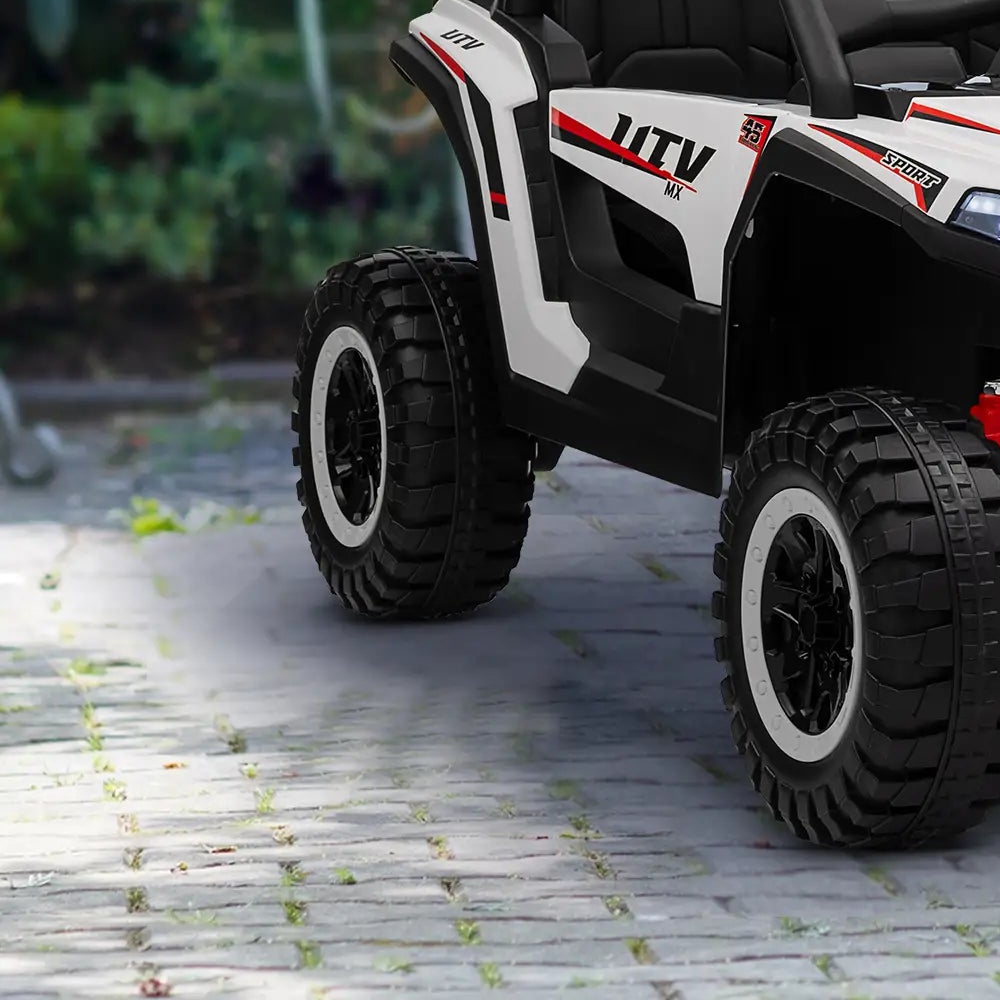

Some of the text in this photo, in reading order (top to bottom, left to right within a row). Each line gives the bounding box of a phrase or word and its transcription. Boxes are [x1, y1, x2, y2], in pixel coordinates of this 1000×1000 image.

[440, 29, 485, 50] UTV
[608, 112, 717, 183] UTV
[880, 150, 942, 189] SPORT
[663, 181, 684, 201] MX
